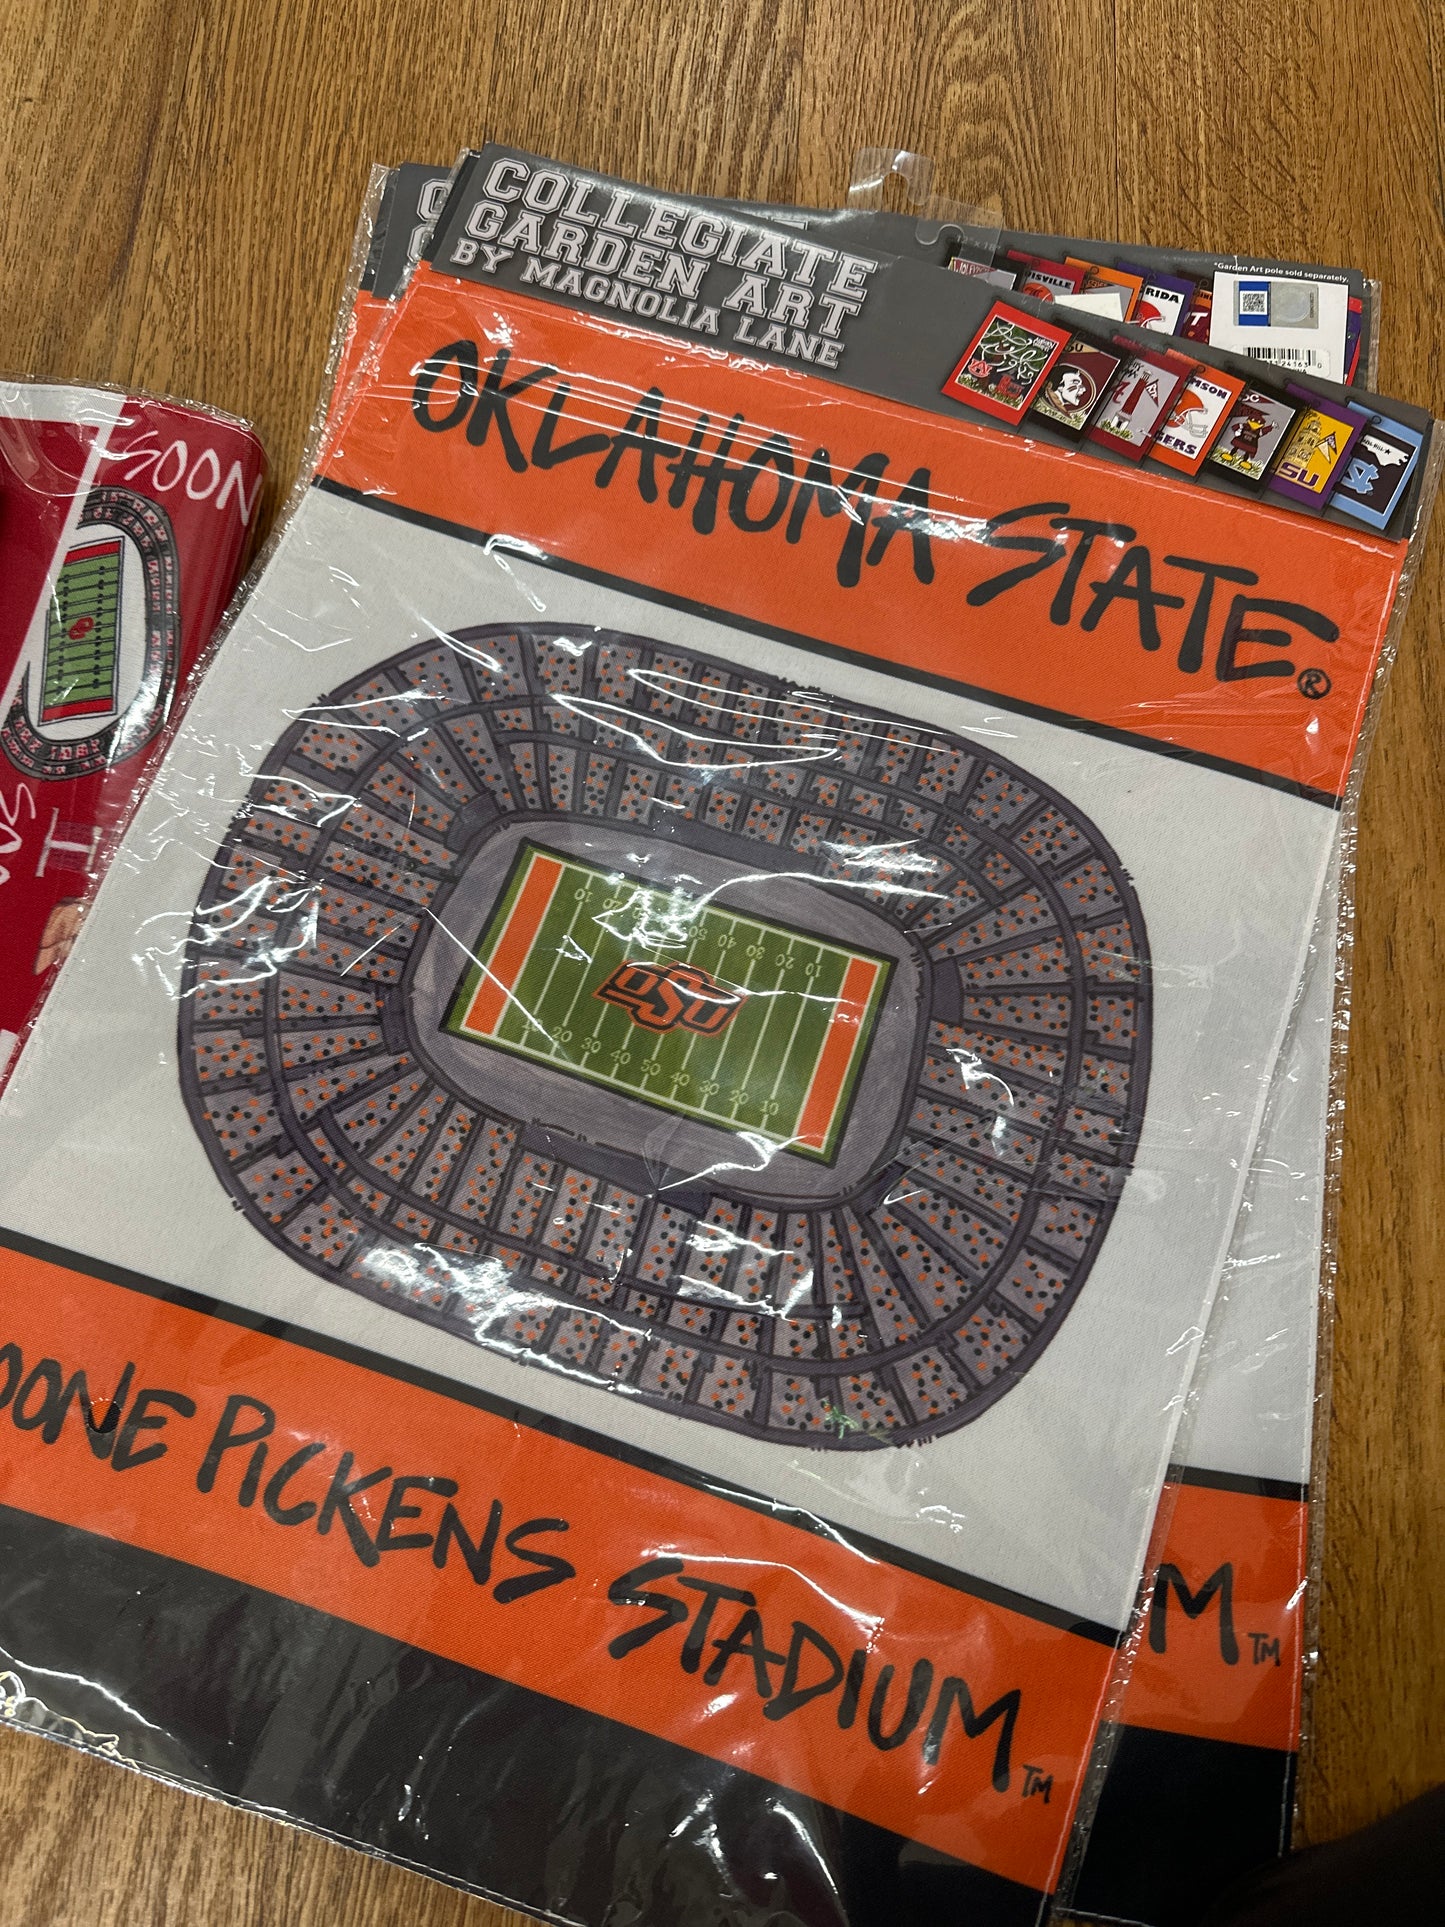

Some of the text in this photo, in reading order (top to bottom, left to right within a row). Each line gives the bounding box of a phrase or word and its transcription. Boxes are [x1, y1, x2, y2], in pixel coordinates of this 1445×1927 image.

[481, 156, 878, 302] COLLEGIATE
[465, 200, 710, 300] GARDEN
[723, 272, 863, 339] ART
[1027, 270, 1072, 289] ISVILLE
[1249, 265, 1263, 273] Art
[1264, 267, 1284, 275] pole
[1285, 269, 1303, 277] sold
[1303, 272, 1349, 283] separately.
[450, 238, 514, 273] BY
[519, 257, 720, 336] MAGNOLIA
[731, 315, 845, 370] LANE
[412, 339, 936, 588] OKLAHOMA
[966, 501, 1340, 682] STATE
[688, 925, 708, 941] 50
[717, 934, 737, 949] 40
[746, 944, 765, 960] 30
[775, 953, 795, 970] 20
[805, 962, 822, 978] 10
[594, 960, 748, 1038] OSU
[552, 1026, 573, 1042] 20
[580, 1037, 601, 1053] 30
[610, 1049, 631, 1065] 40
[640, 1059, 661, 1076] 50
[670, 1072, 690, 1086] 40
[700, 1080, 720, 1096] 30
[729, 1089, 749, 1105] 20
[760, 1100, 779, 1116] 10
[196, 1394, 577, 1605] PICKENS
[607, 1556, 1022, 1794] STADIUM
